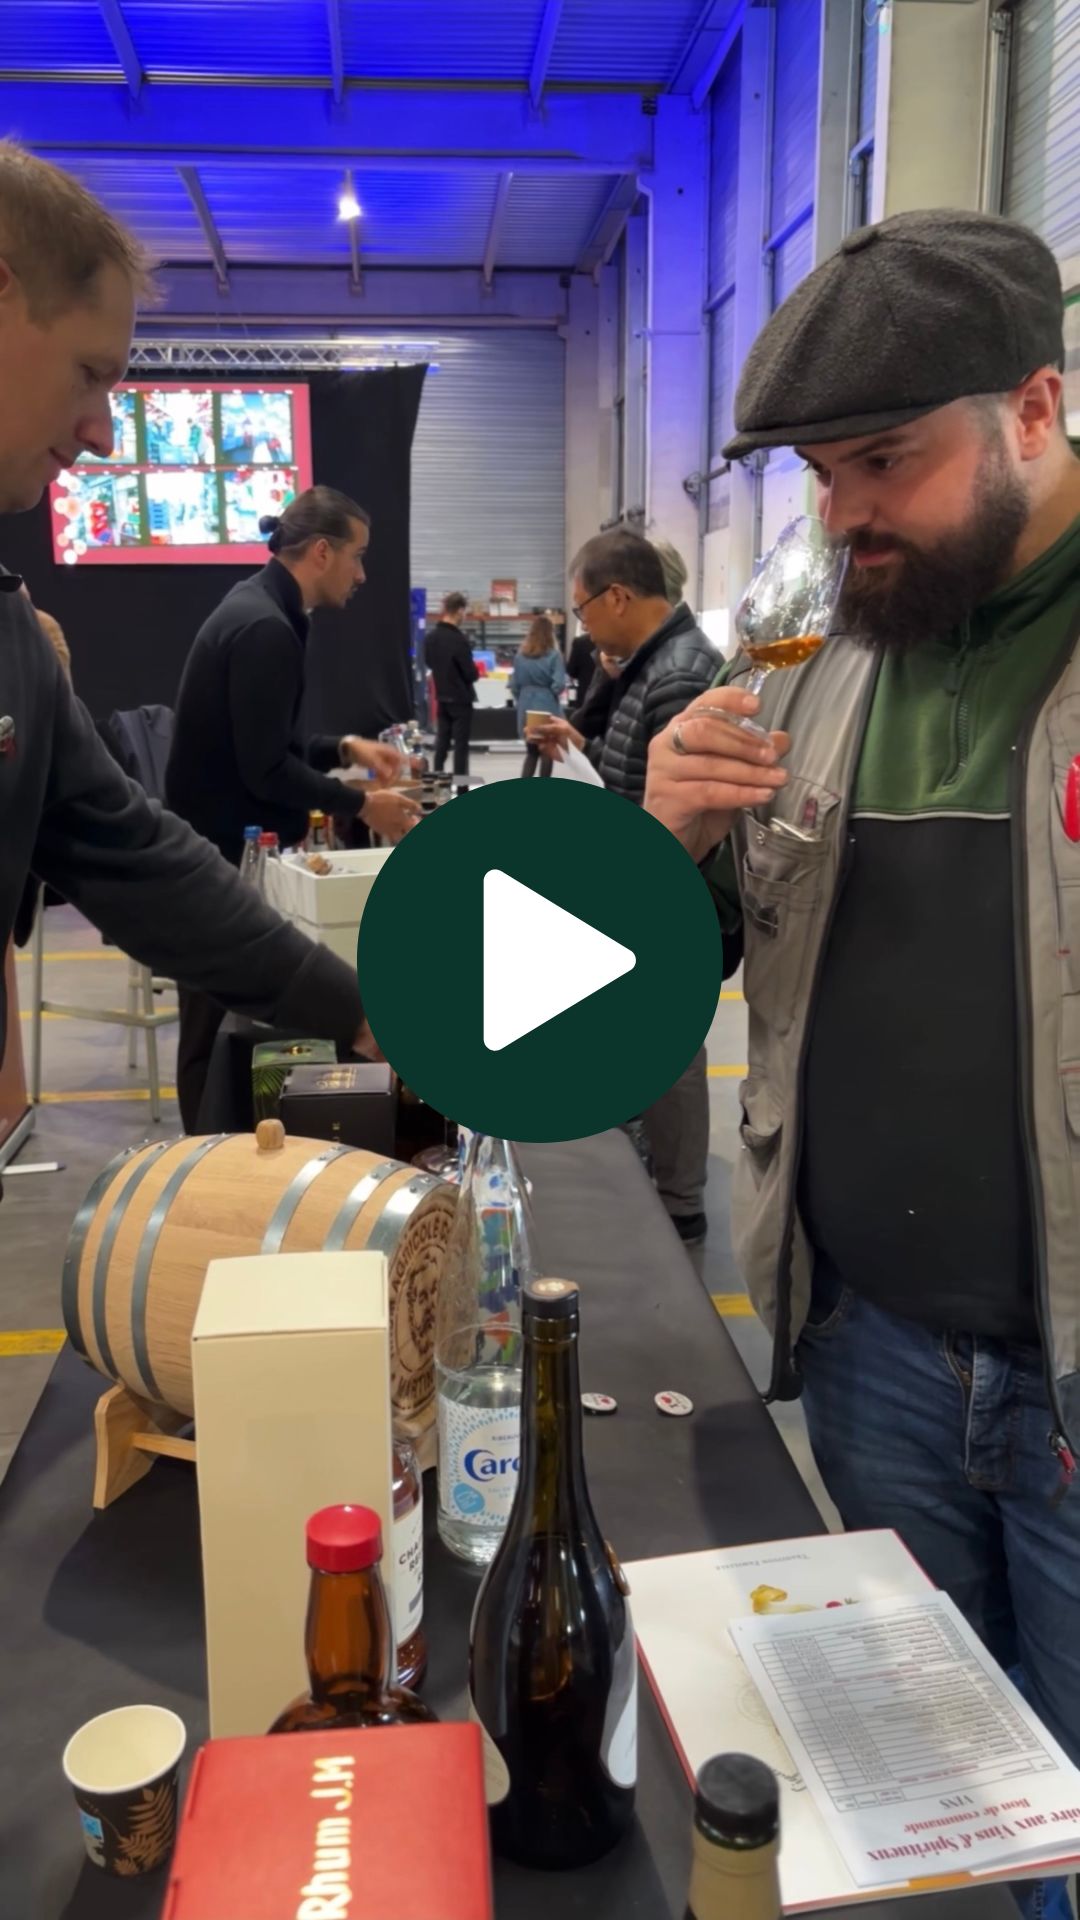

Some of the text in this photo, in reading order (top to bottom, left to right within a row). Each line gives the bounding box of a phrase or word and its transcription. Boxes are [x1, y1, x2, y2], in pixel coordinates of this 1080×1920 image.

[939, 1794, 974, 1810] VINS
[904, 1798, 1031, 1836] Bon de commande
[1014, 1813, 1048, 1830] aux
[296, 1756, 356, 1920] Rhum J.M
[962, 1833, 974, 1849] &
[975, 1824, 1017, 1841] Vins
[867, 1835, 962, 1862] Spiritueux
